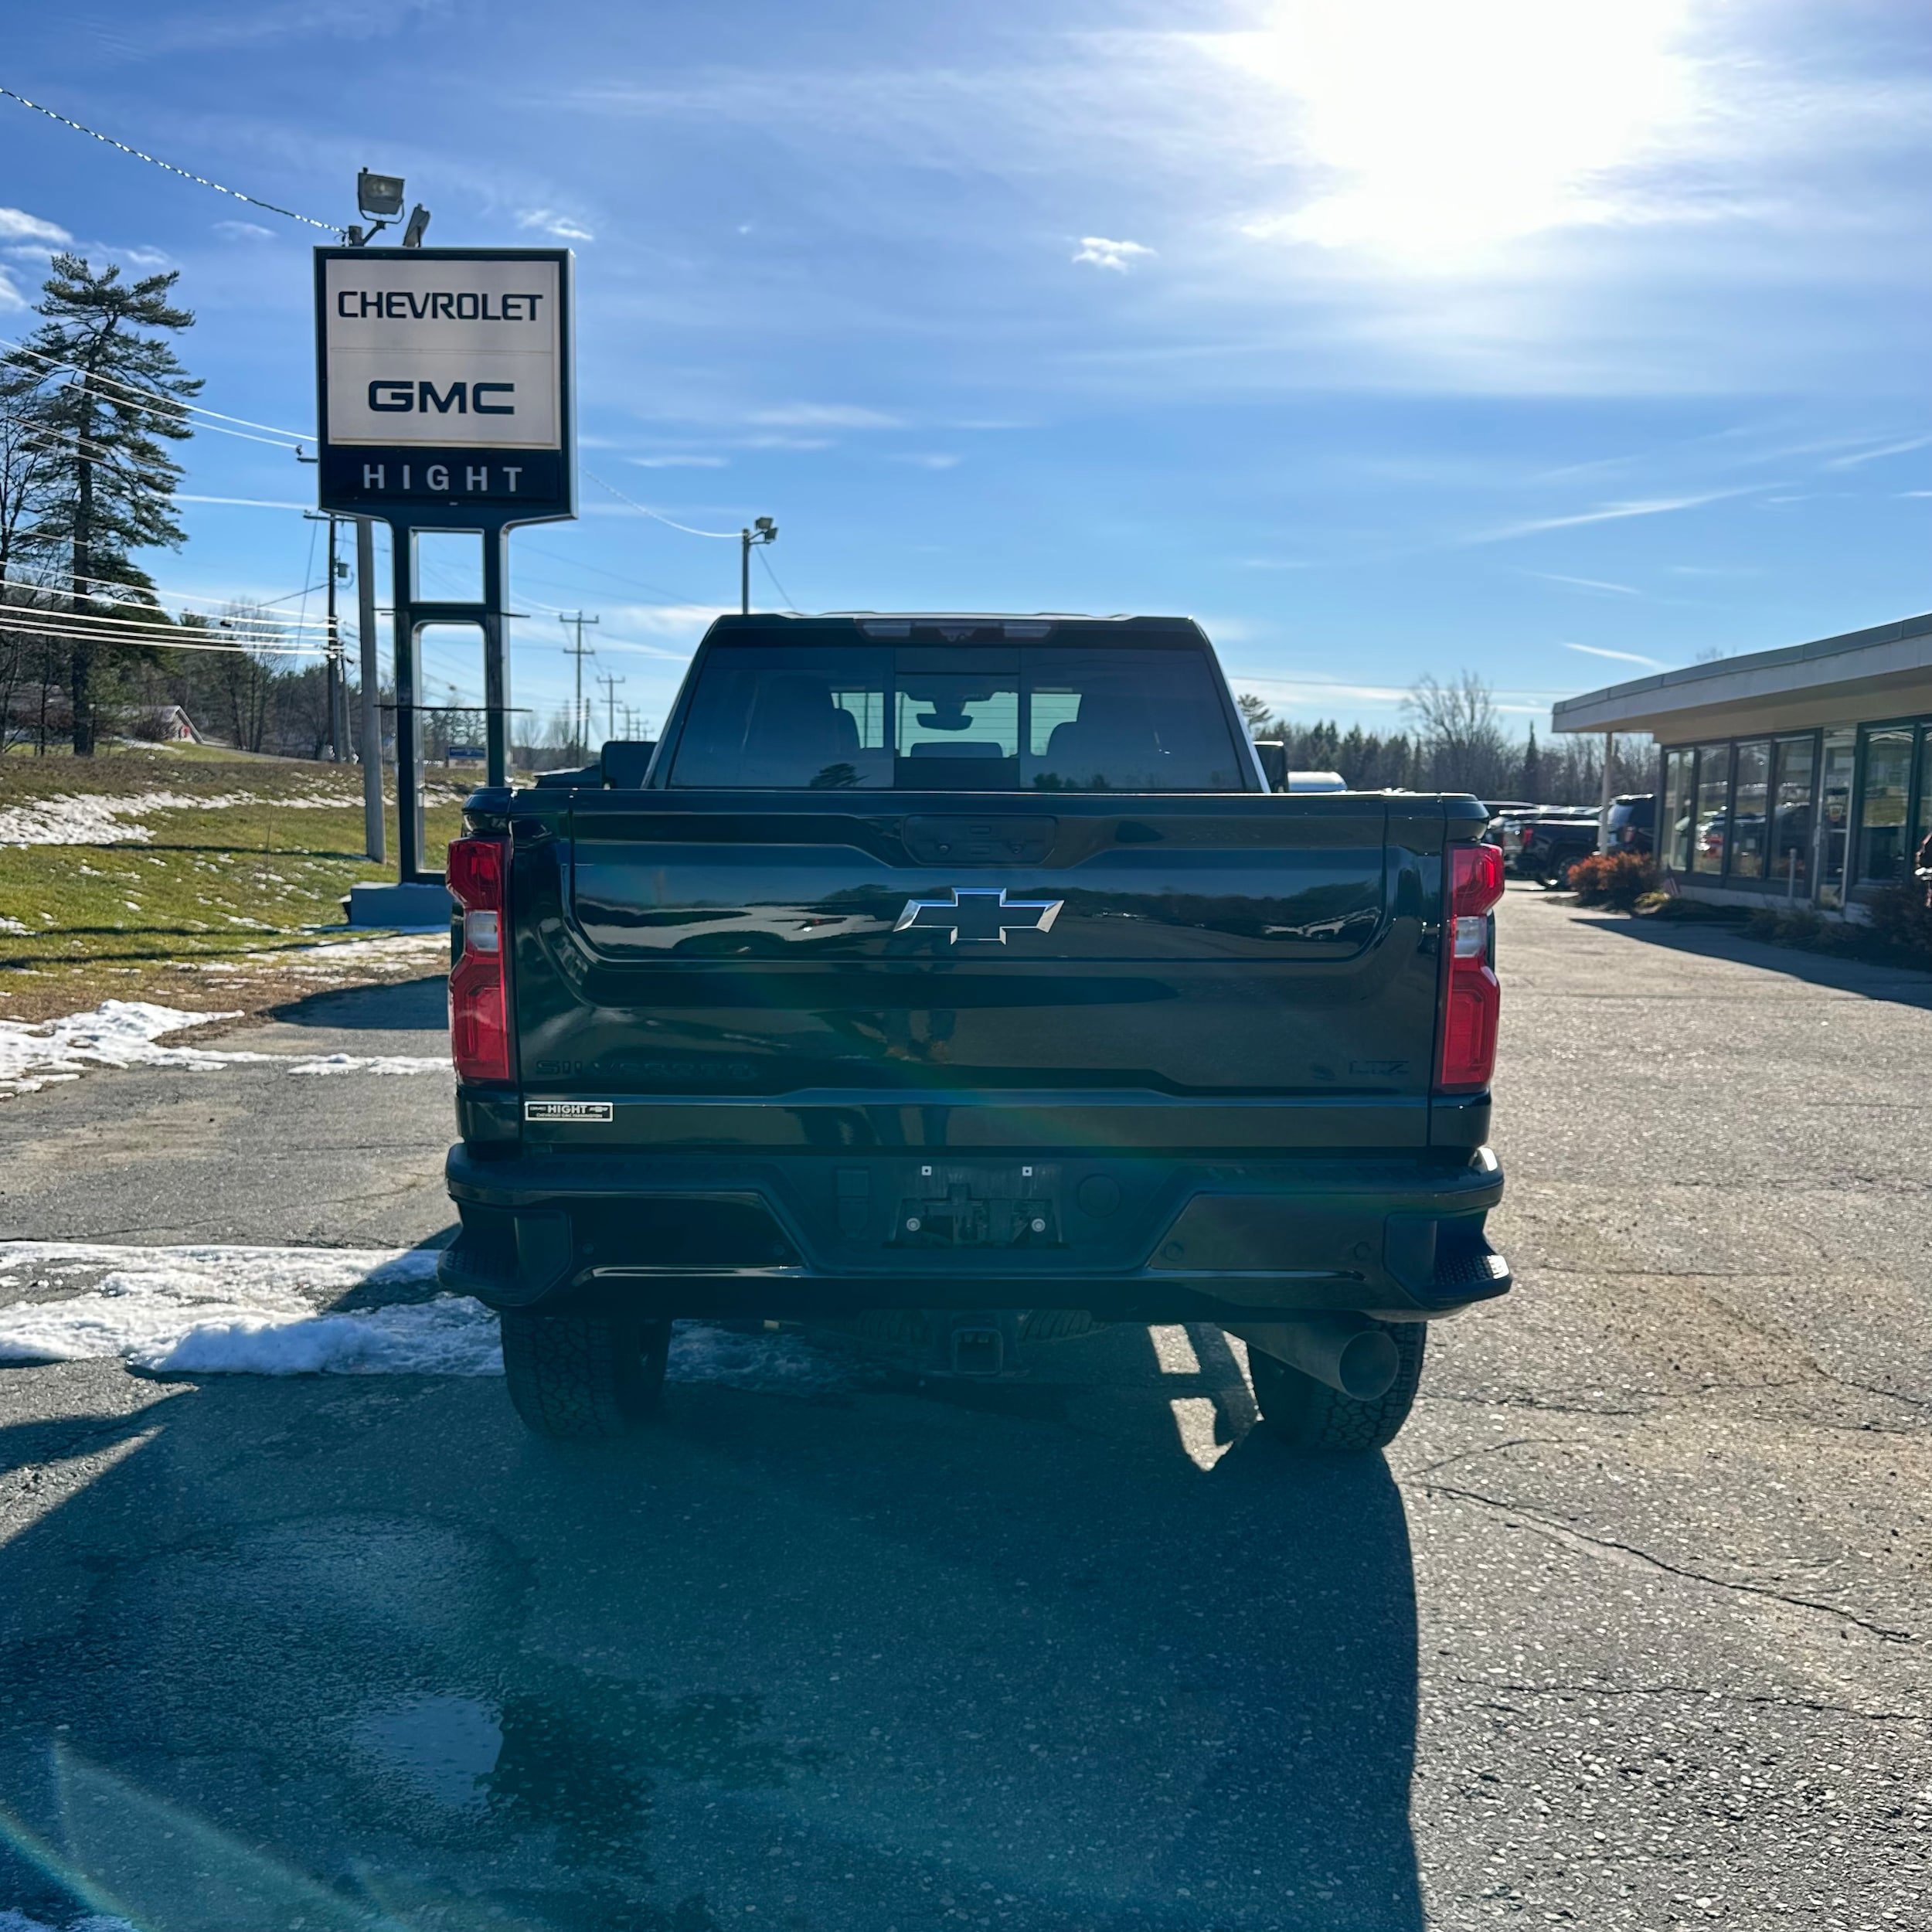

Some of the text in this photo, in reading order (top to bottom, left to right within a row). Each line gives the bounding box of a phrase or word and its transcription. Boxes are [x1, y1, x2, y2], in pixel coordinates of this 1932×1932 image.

[338, 291, 543, 321] CHEVROLET
[369, 380, 515, 415] GMC
[363, 464, 523, 492] HIGHT
[547, 1105, 587, 1114] HIGHT
